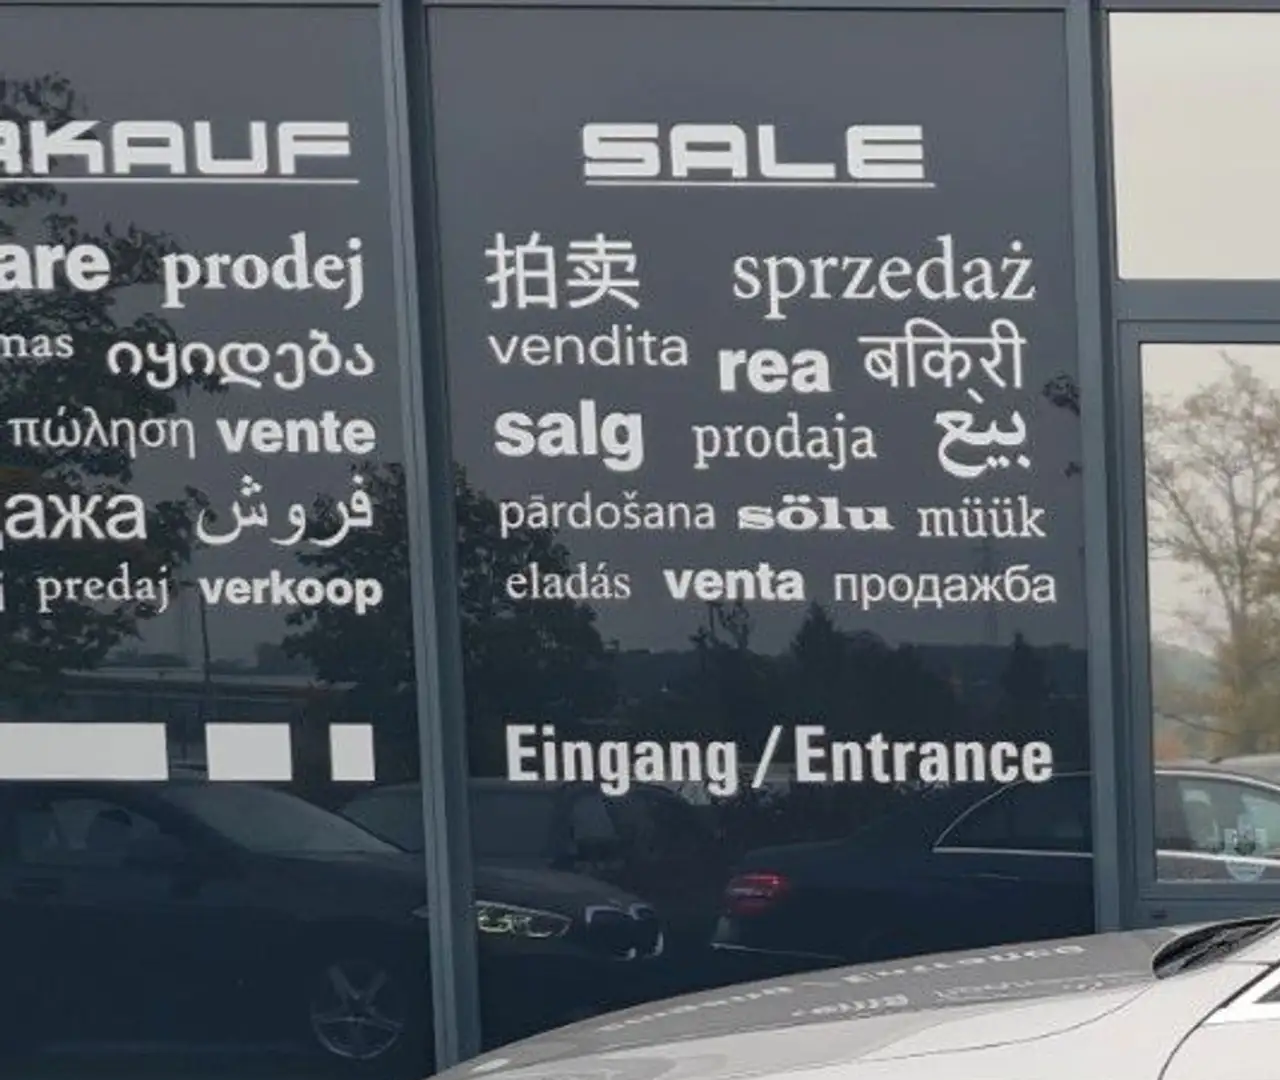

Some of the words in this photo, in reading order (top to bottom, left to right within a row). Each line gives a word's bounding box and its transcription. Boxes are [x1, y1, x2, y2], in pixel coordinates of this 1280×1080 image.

[582, 123, 924, 179] SALE
[162, 232, 363, 310] prodej
[485, 231, 640, 309] 拍卖
[733, 234, 1036, 319] sprzedaż
[108, 329, 374, 390] იყიდება
[488, 324, 688, 366] vendita
[719, 350, 831, 393] rea
[8, 407, 195, 458] πώληση
[216, 411, 375, 454] vente
[495, 399, 643, 471] salg
[692, 412, 877, 470] prodaja
[0, 494, 146, 550] ажа
[197, 475, 372, 546] فروش
[500, 491, 715, 538] pārdošana
[738, 495, 894, 531] sölu
[918, 496, 1046, 537] müük
[38, 563, 168, 612] predaj
[199, 570, 382, 614] verkoop
[507, 562, 630, 599] eladás
[663, 563, 804, 601] venta
[835, 564, 1056, 610] продажба
